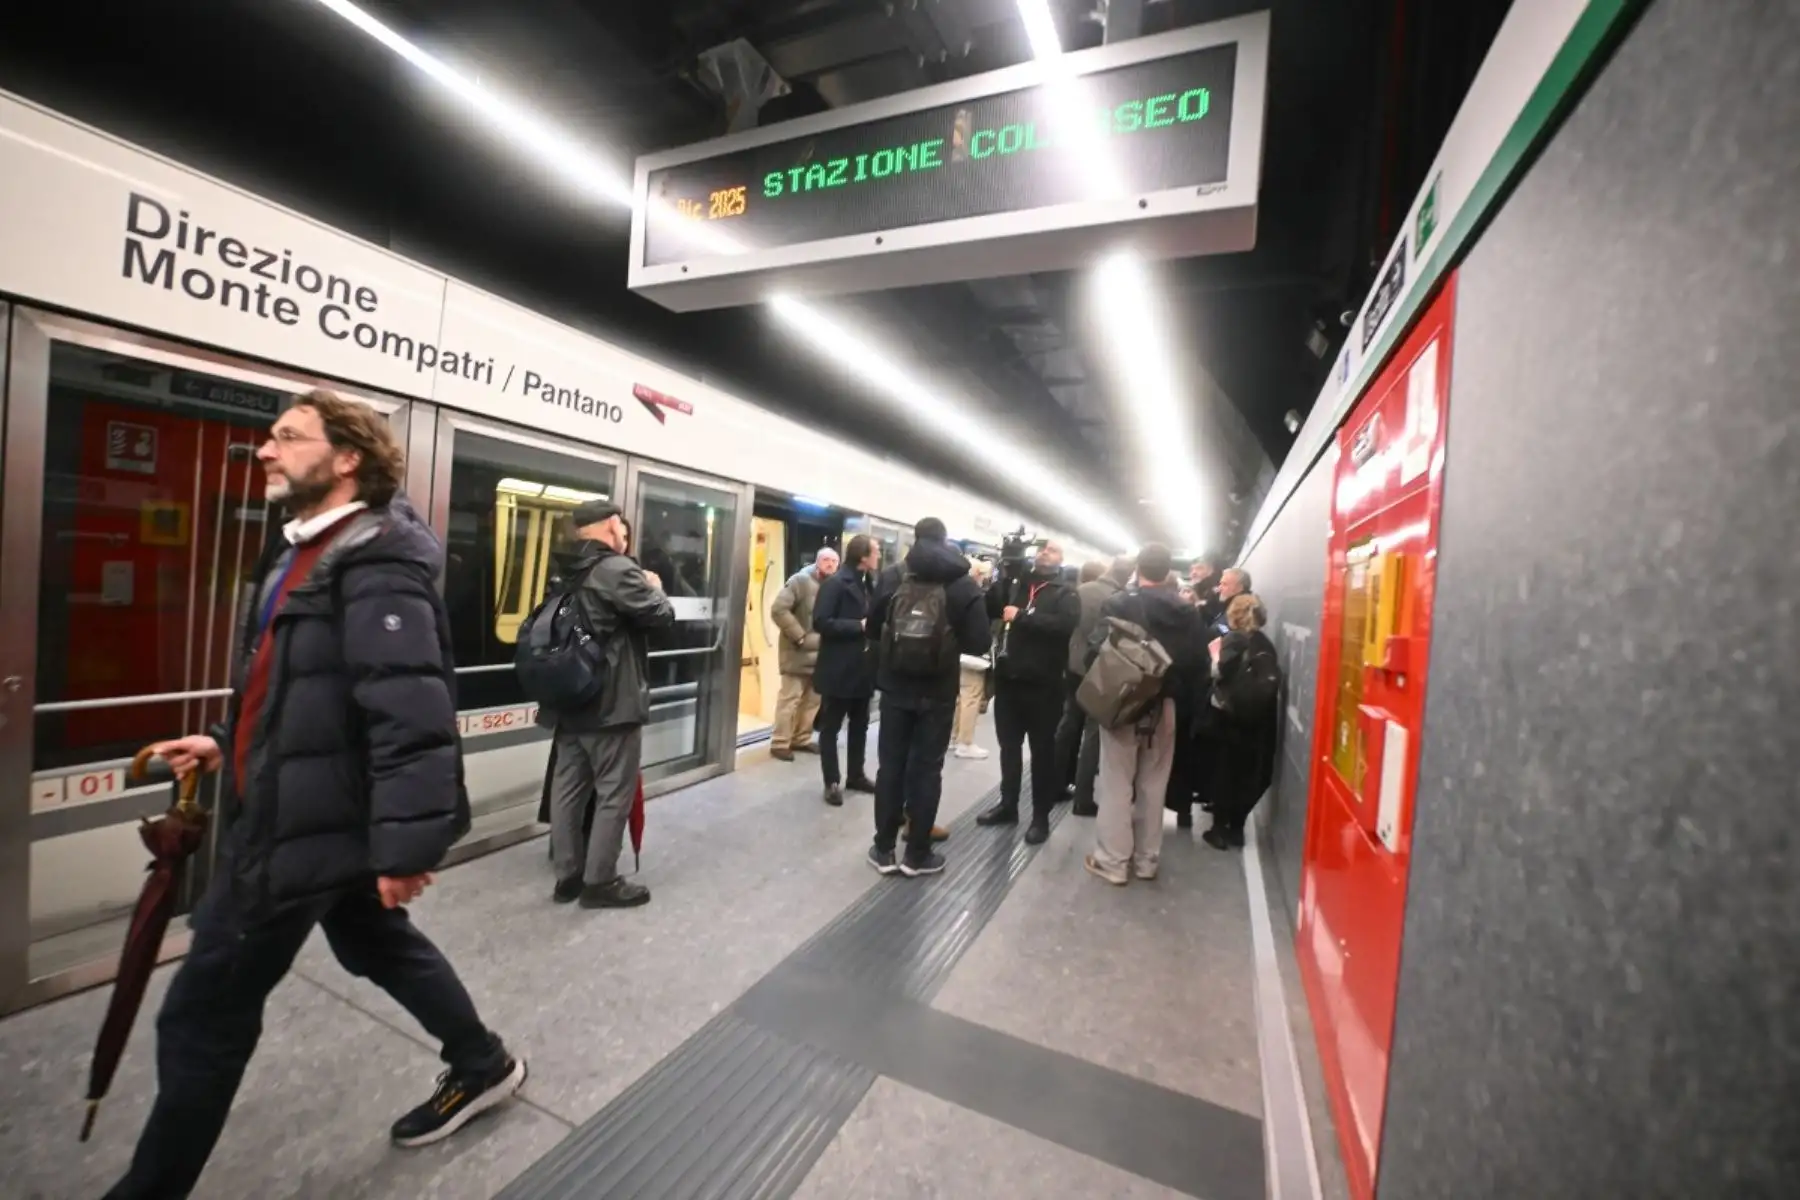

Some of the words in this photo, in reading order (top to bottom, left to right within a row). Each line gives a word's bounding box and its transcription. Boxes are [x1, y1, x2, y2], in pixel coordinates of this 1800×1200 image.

[763, 138, 945, 198] STAZIONE
[970, 87, 1210, 160] COLSEO
[708, 186, 747, 220] 2025
[126, 192, 378, 313] Direzione
[122, 237, 300, 326] Monte
[318, 303, 494, 385] Compatri
[502, 364, 516, 393] /
[523, 369, 624, 424] Pantano
[483, 712, 514, 729] S2C
[79, 771, 114, 796] 01
